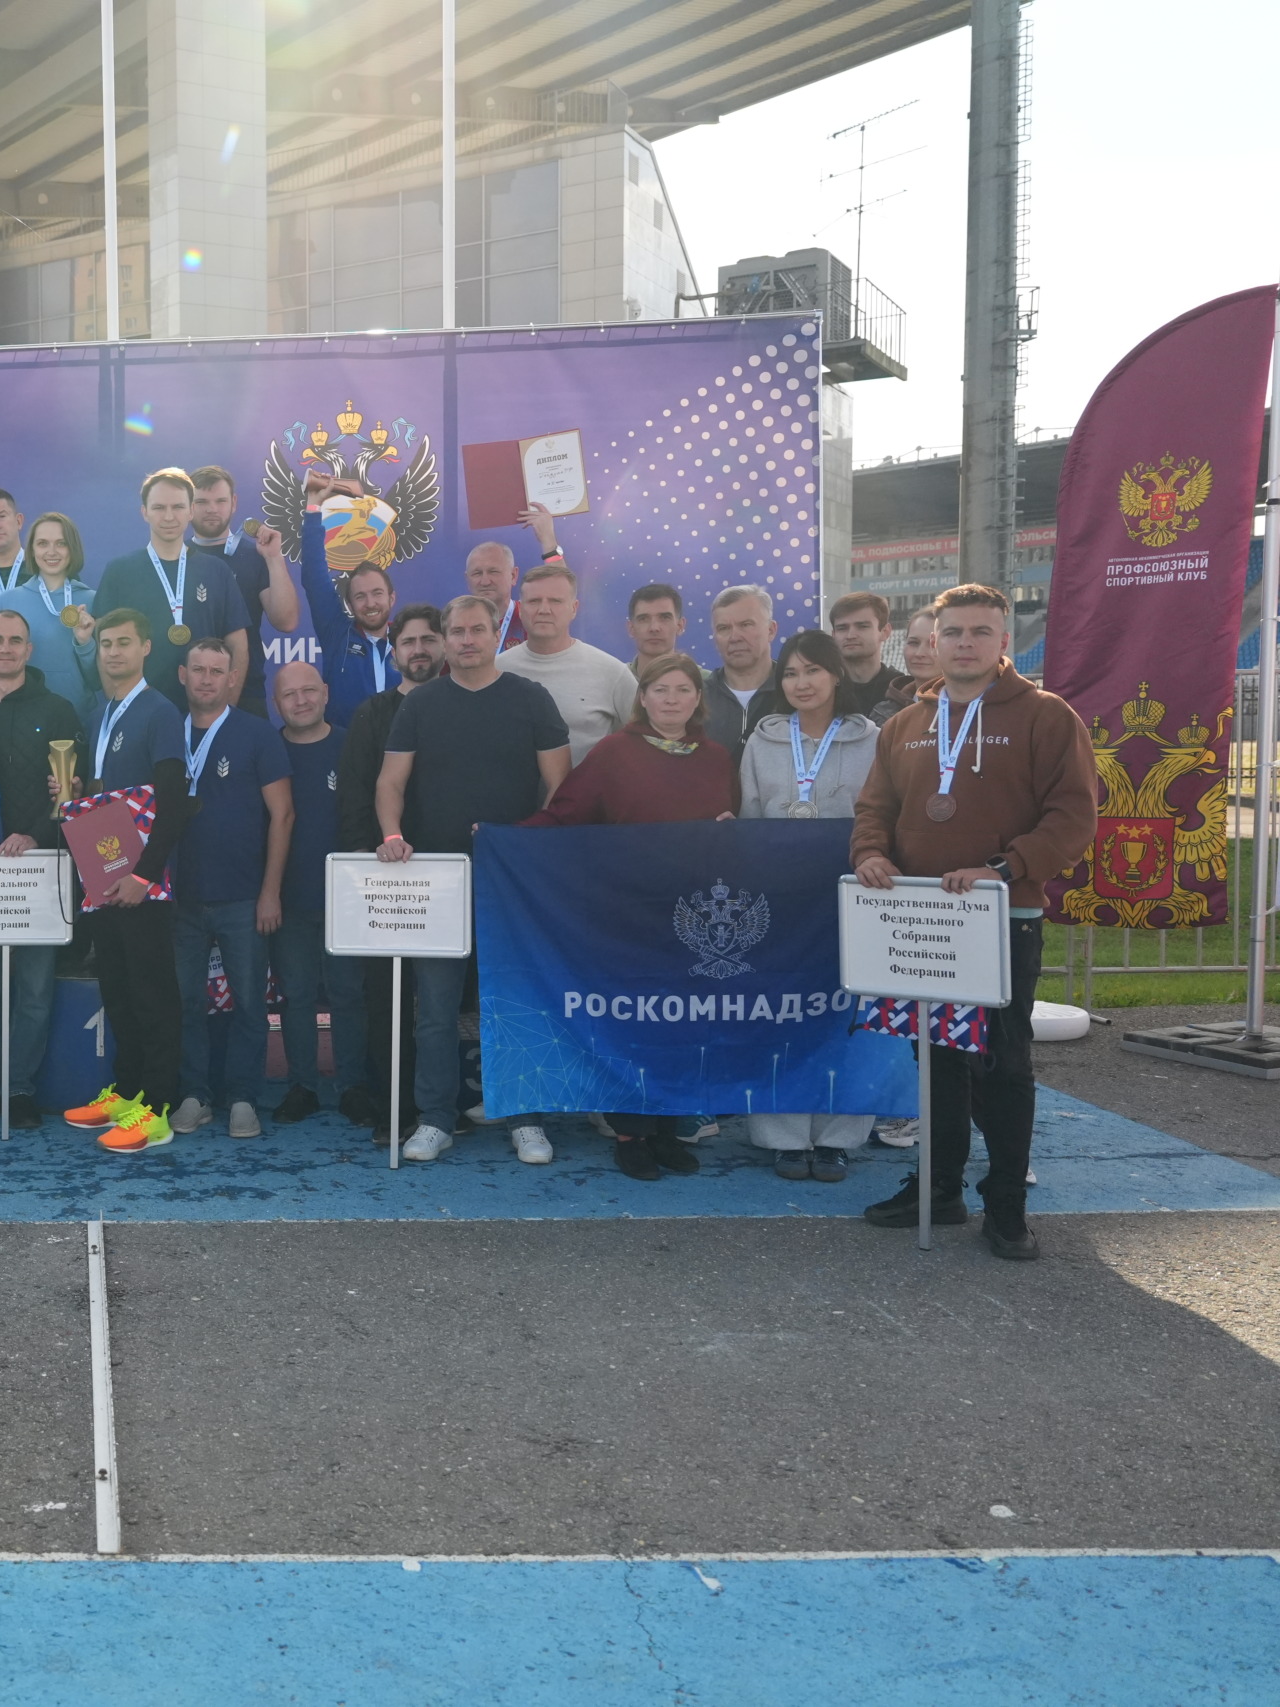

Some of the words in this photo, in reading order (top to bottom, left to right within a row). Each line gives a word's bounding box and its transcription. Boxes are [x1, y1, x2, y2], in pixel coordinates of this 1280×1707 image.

[868, 541, 942, 557] ПОДМОСКОВЬЕ
[1106, 556, 1209, 576] ПРОФСОЮЗНЫЙ
[868, 579, 900, 591] СПОРТ
[913, 577, 939, 588] ТРУД
[1105, 572, 1174, 587] СПОРТИВНЫЙ
[1177, 571, 1208, 582] КЛУБ
[904, 739, 937, 750] TOMM
[364, 878, 431, 888] Генеральная
[364, 894, 430, 903] прокуратура
[855, 895, 954, 909] Государственная
[957, 900, 990, 913] Дума
[368, 905, 427, 915] Российской
[368, 920, 426, 931] Федерации
[879, 912, 964, 927] Федерального
[892, 929, 951, 943] Собрания
[888, 946, 957, 961] Российской
[889, 964, 956, 979] Федерации
[83, 1006, 105, 1057] 1
